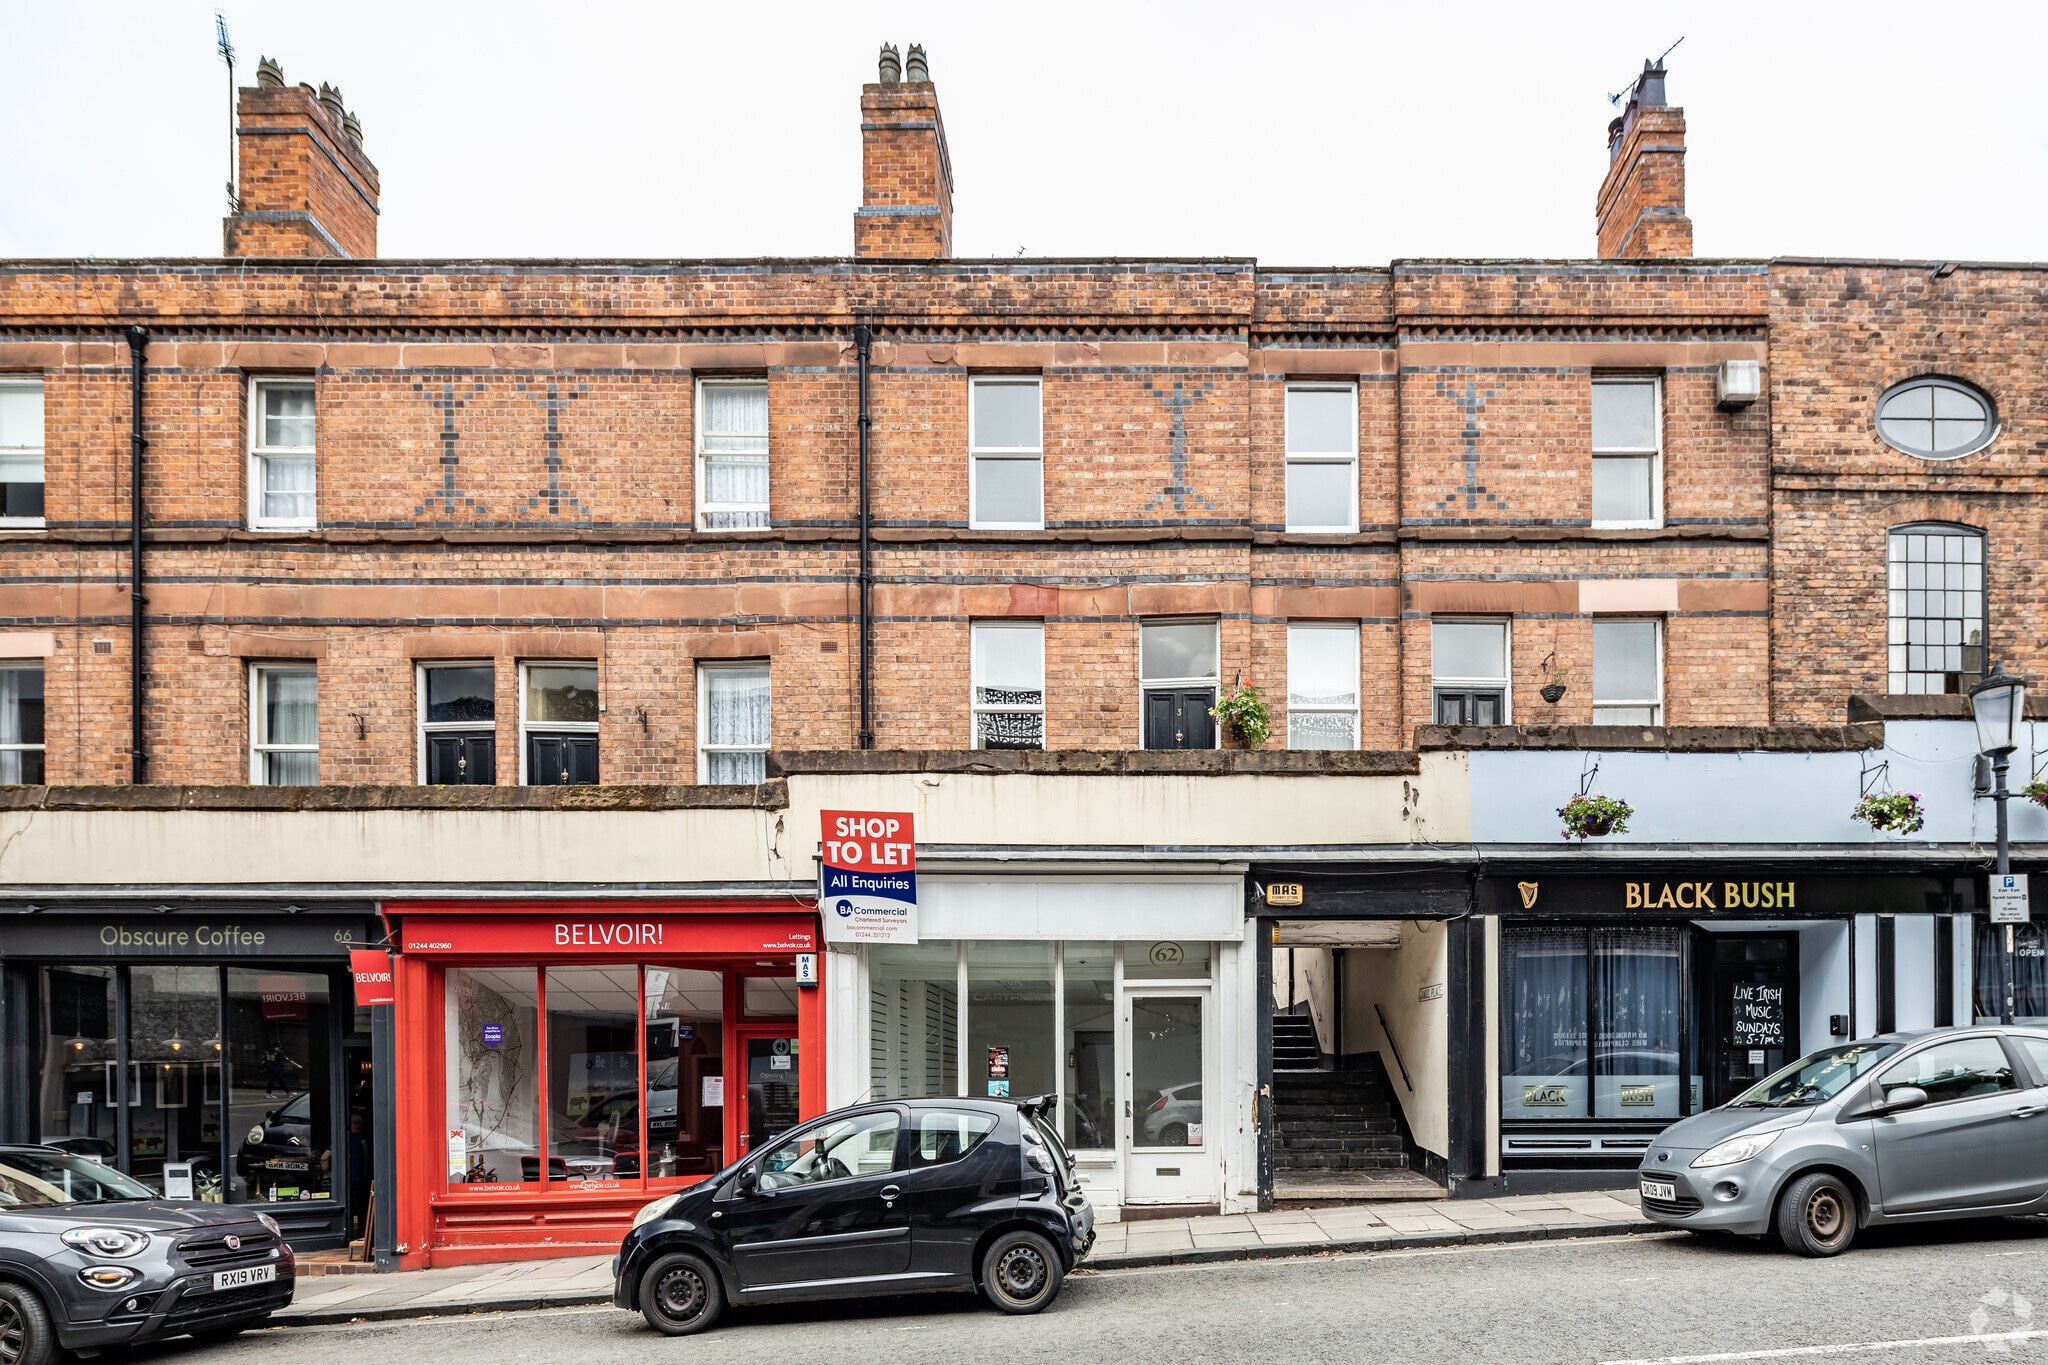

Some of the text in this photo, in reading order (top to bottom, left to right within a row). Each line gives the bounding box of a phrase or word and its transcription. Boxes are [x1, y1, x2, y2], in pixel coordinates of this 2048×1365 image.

[1176, 708, 1182, 716] 3
[460, 738, 465, 746] 5
[836, 817, 900, 838] SHOP
[826, 841, 912, 865] TO LET
[831, 875, 910, 892] All Enquiries
[1625, 881, 1796, 909] BLACK BUSH
[839, 906, 908, 916] BA Commercial
[554, 923, 664, 945] BELVOIR!
[846, 924, 898, 932] bacommercial.com
[100, 925, 266, 946] Obscure Coffee
[334, 929, 352, 942] 66
[788, 933, 811, 941] Lettings
[1154, 947, 1178, 962] 62
[2019, 948, 2043, 957] OPEN
[355, 972, 391, 983] BELVOIR!
[1733, 985, 1782, 1006] LIVE IRISH
[1745, 1003, 1773, 1020] MUSIC
[1735, 1020, 1781, 1035] SUNDAYS
[760, 1072, 784, 1080] Opening
[1525, 1090, 1566, 1102] BLACK
[1621, 1089, 1654, 1102] BUSH
[468, 1183, 521, 1191] www.belvoir.co.uk
[568, 1181, 621, 1189] www.belvoir.co.uk
[1643, 1182, 1673, 1198] DK09 JVM
[221, 1266, 270, 1287] RX19 VRV
